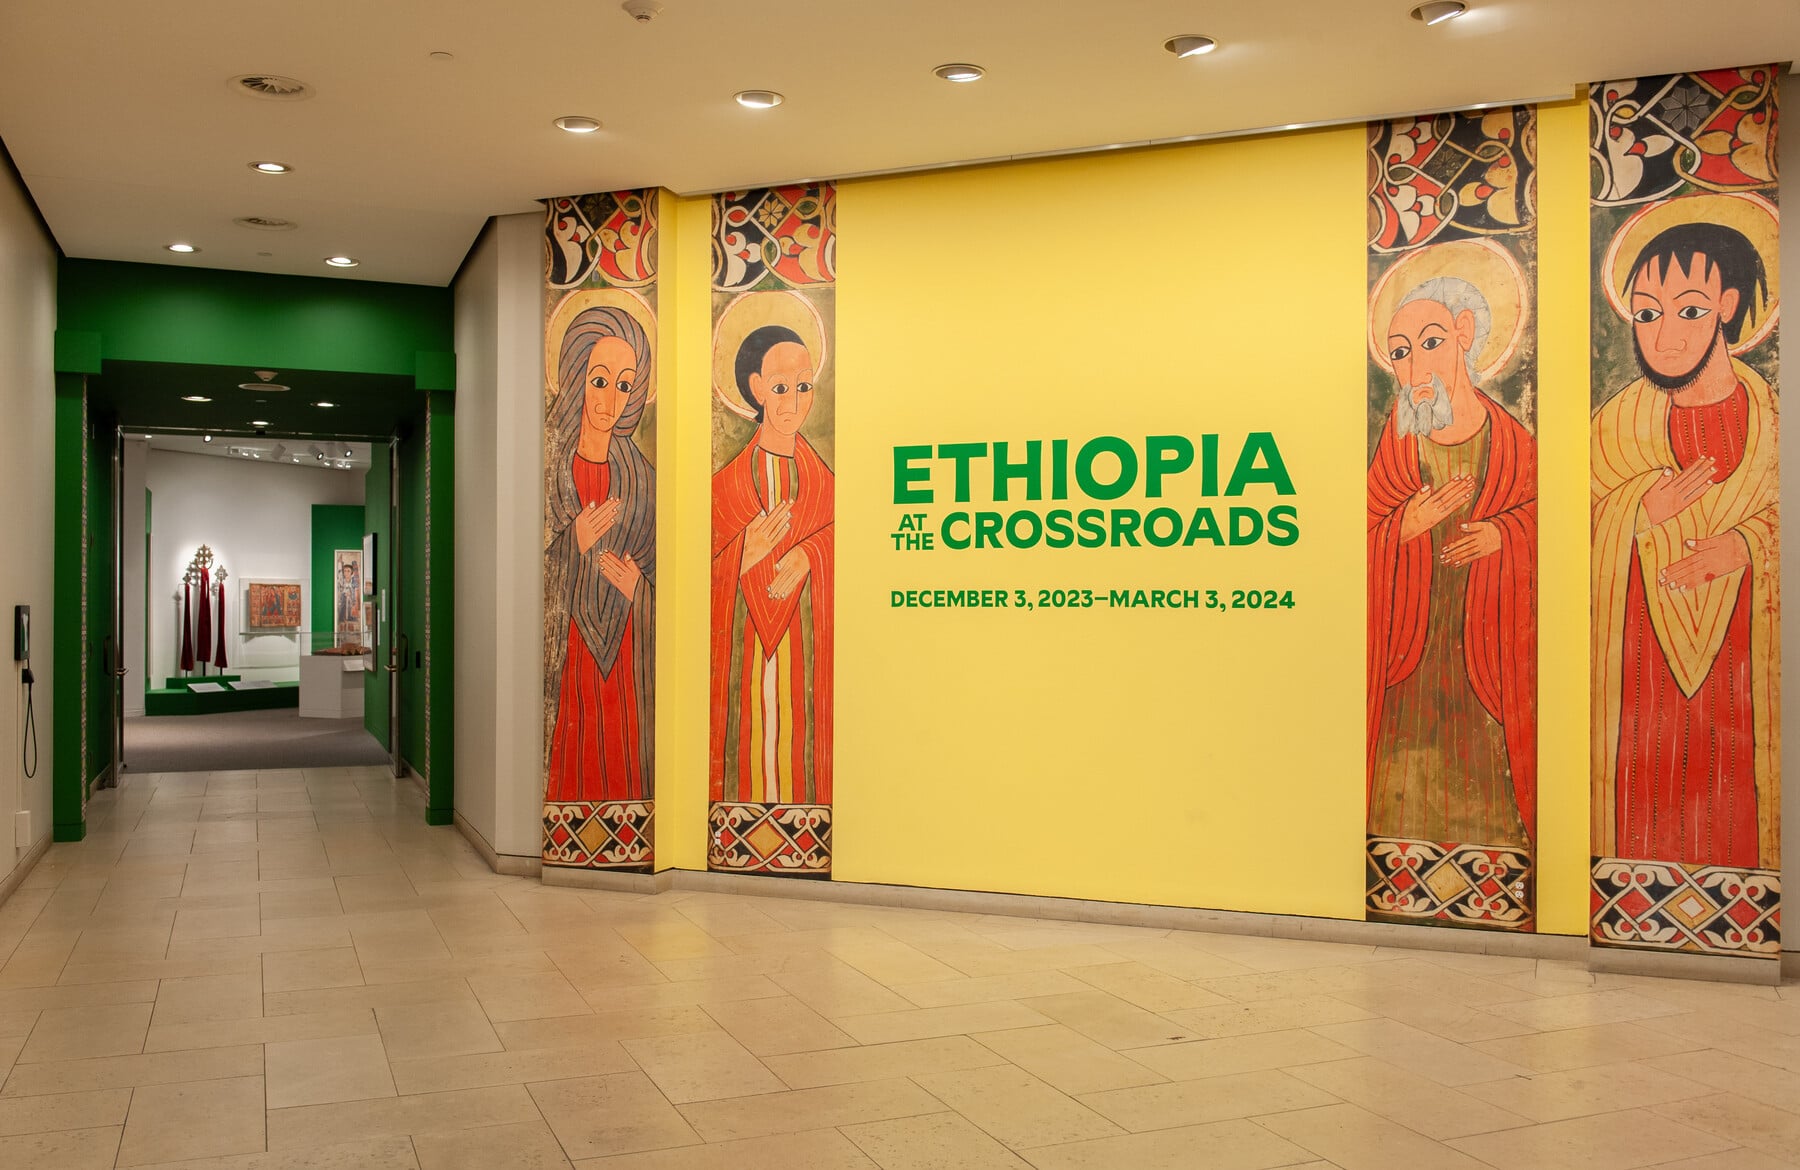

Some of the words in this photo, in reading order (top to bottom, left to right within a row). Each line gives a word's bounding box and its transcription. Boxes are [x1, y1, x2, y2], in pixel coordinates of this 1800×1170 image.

[893, 431, 1297, 505] ETHIOPIA
[898, 513, 928, 532] AT
[940, 504, 1300, 550] CROSSROADS
[890, 532, 934, 551] THE
[890, 590, 1009, 608] DECEMBER
[1013, 589, 1034, 611] 3,
[1205, 590, 1227, 612] 3,
[1231, 589, 1296, 609] 2024
